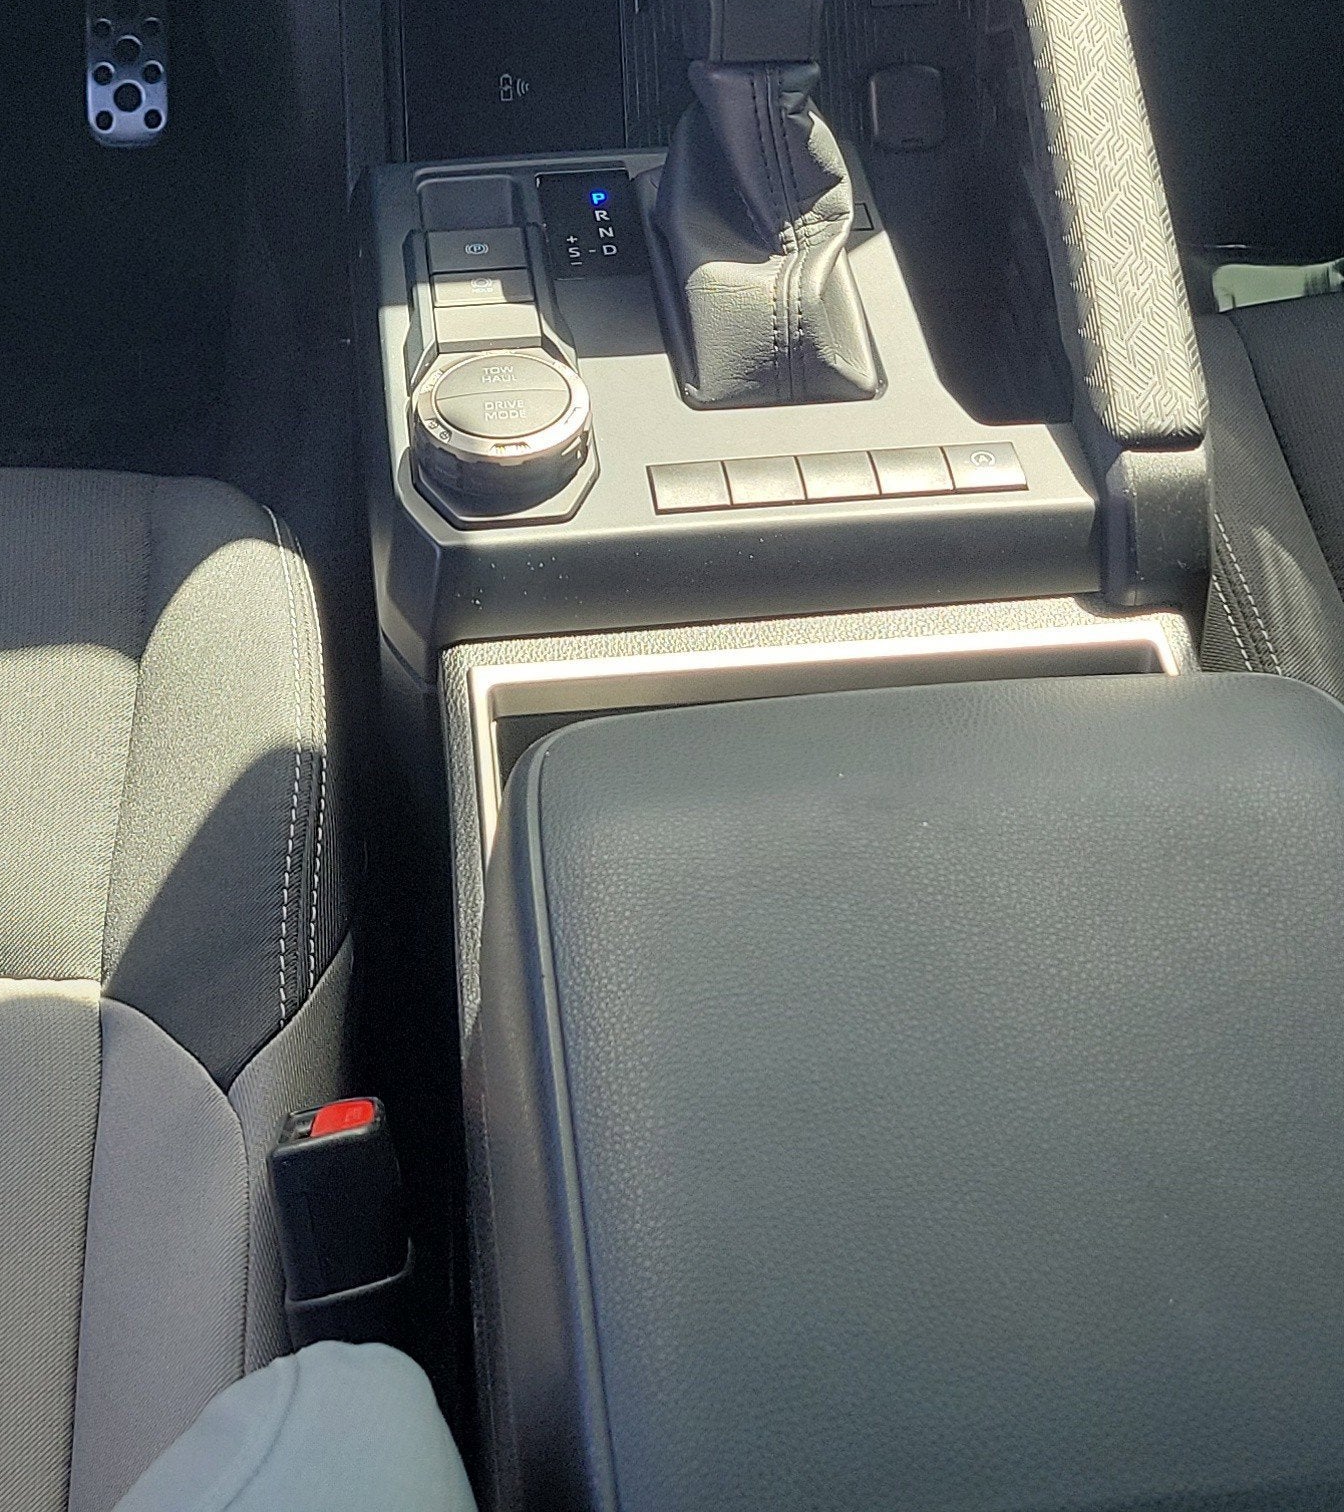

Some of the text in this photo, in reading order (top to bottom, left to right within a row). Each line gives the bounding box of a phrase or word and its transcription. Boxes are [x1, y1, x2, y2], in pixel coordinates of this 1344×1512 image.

[591, 193, 606, 205] P
[594, 210, 610, 222] R
[598, 226, 614, 238] N
[568, 244, 617, 258] S D
[482, 366, 514, 375] TOW
[482, 374, 518, 384] HAUL
[484, 400, 525, 411] DRIVE
[484, 409, 527, 421] MODE
